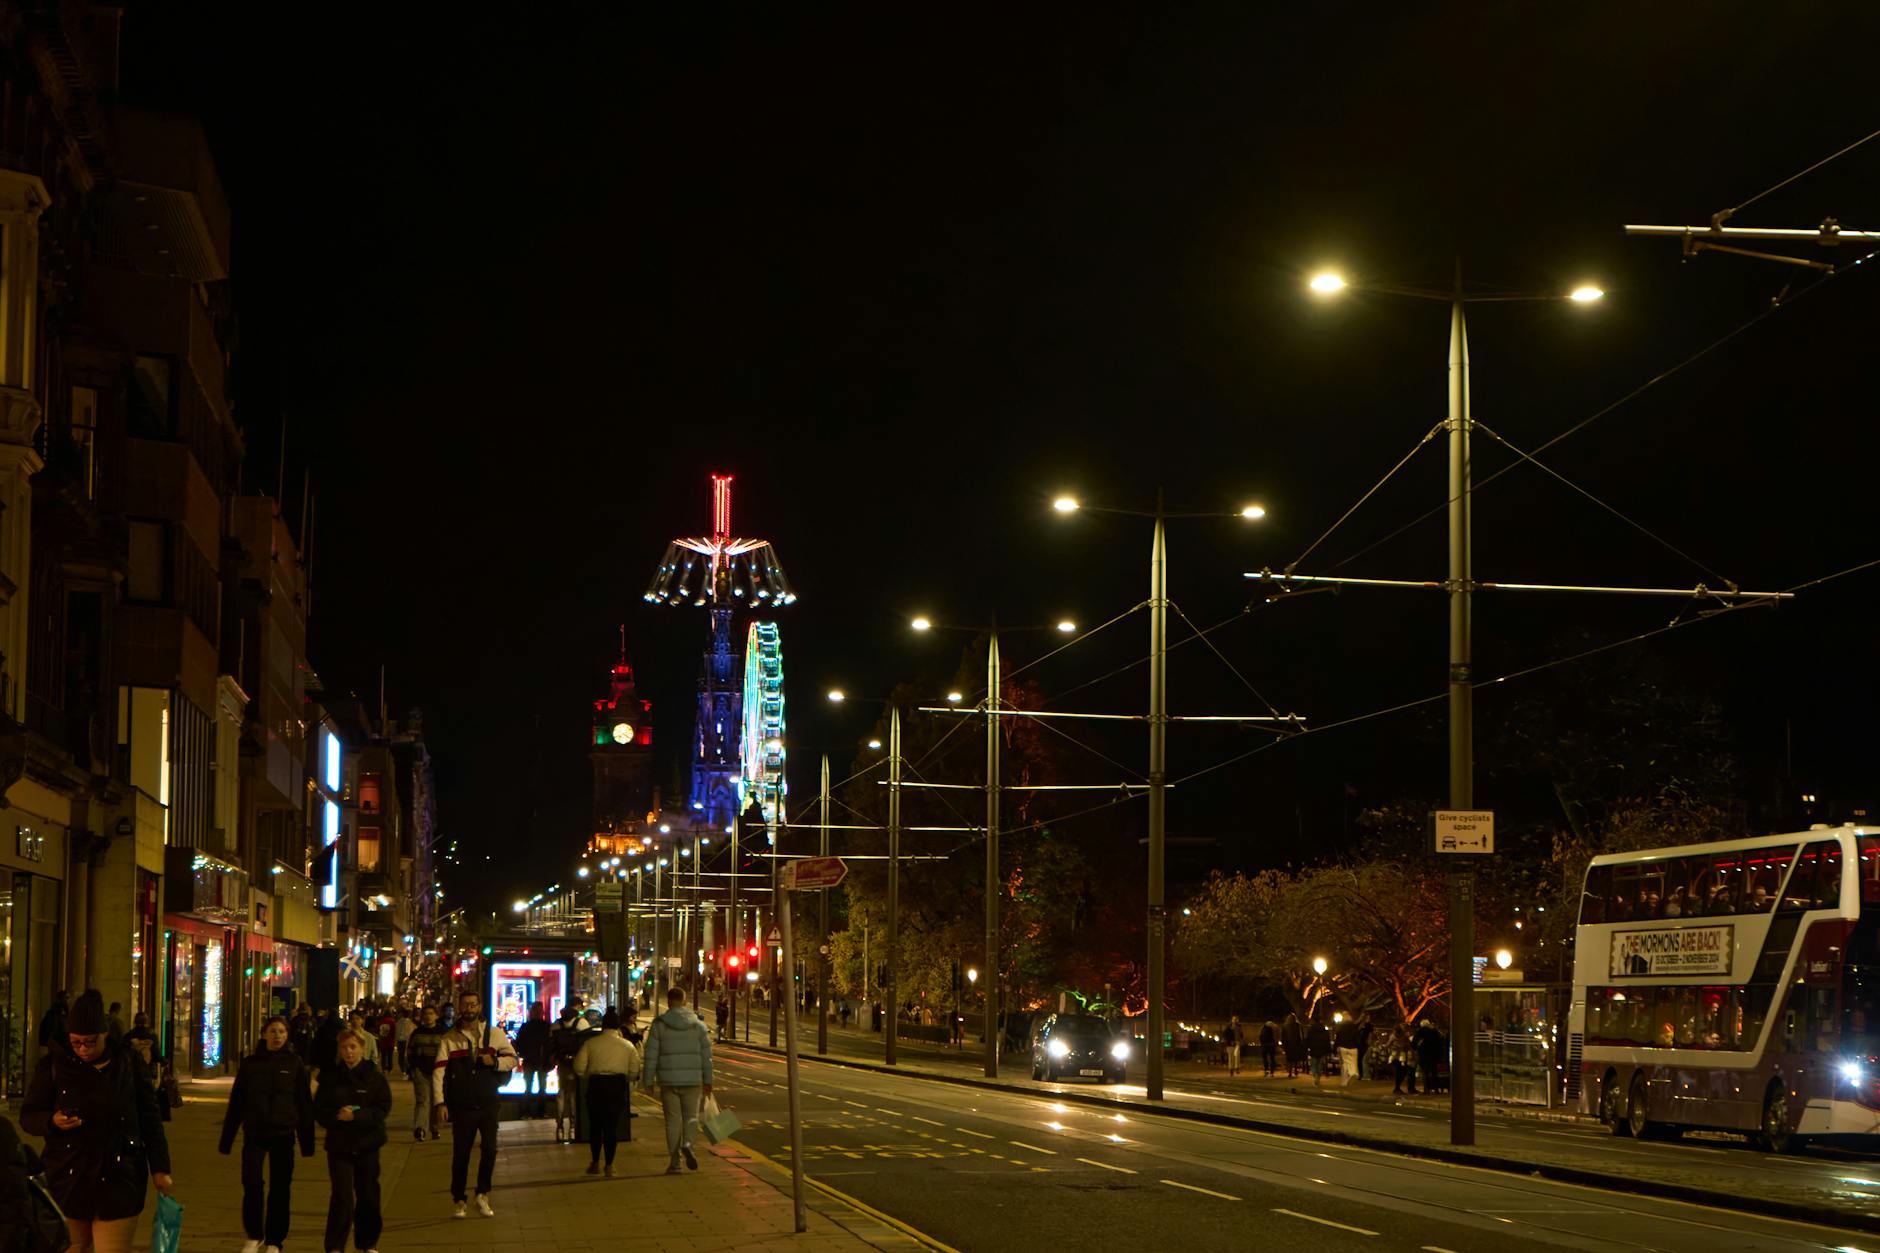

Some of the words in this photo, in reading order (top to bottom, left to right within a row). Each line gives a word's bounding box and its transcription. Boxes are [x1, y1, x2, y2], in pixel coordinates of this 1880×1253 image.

[1459, 814, 1490, 822] cyclists
[1626, 935, 1640, 953] THE
[1640, 933, 1679, 953] MORMONS
[1680, 931, 1696, 952] ARE
[1697, 930, 1720, 951] BACK!
